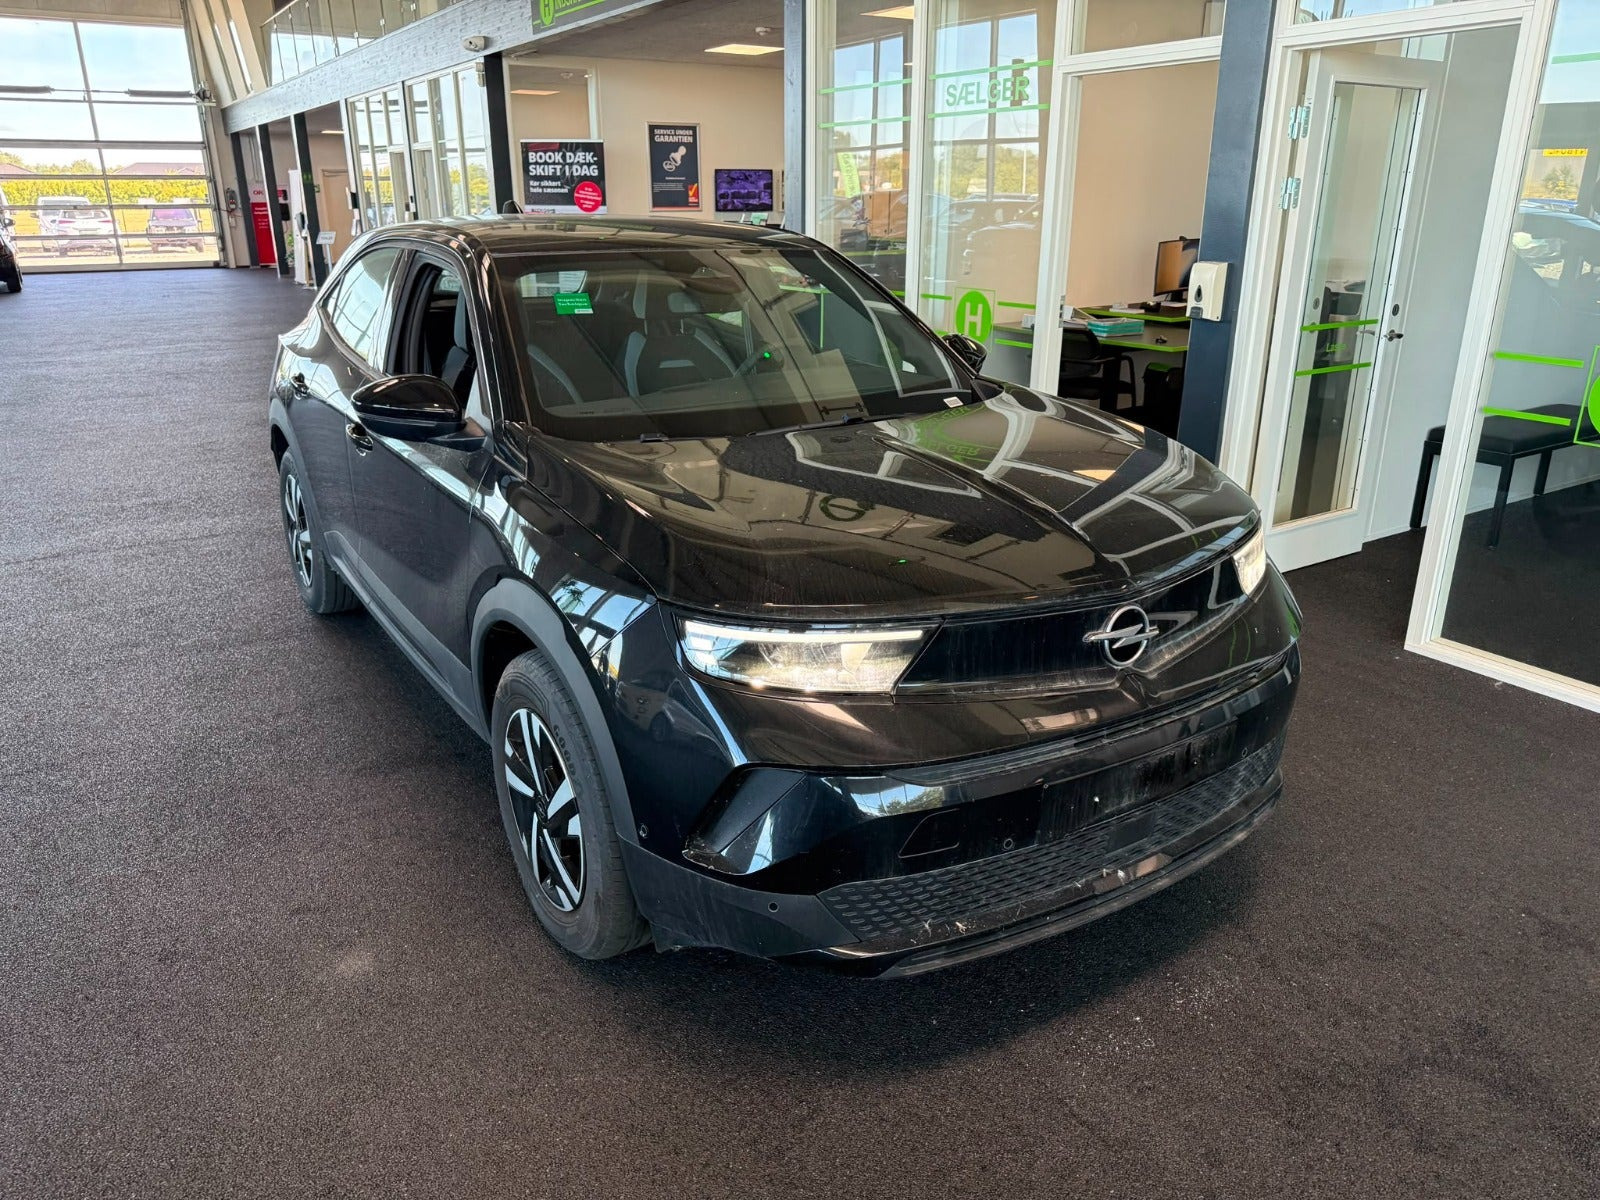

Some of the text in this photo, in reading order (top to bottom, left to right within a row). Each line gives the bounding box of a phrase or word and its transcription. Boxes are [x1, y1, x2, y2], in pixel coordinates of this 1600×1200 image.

[945, 76, 1030, 107] SÆLGER
[654, 135, 693, 143] GARANTIEN
[528, 152, 598, 163] BOOK DÆK-
[529, 165, 599, 176] SKIFT I DAG
